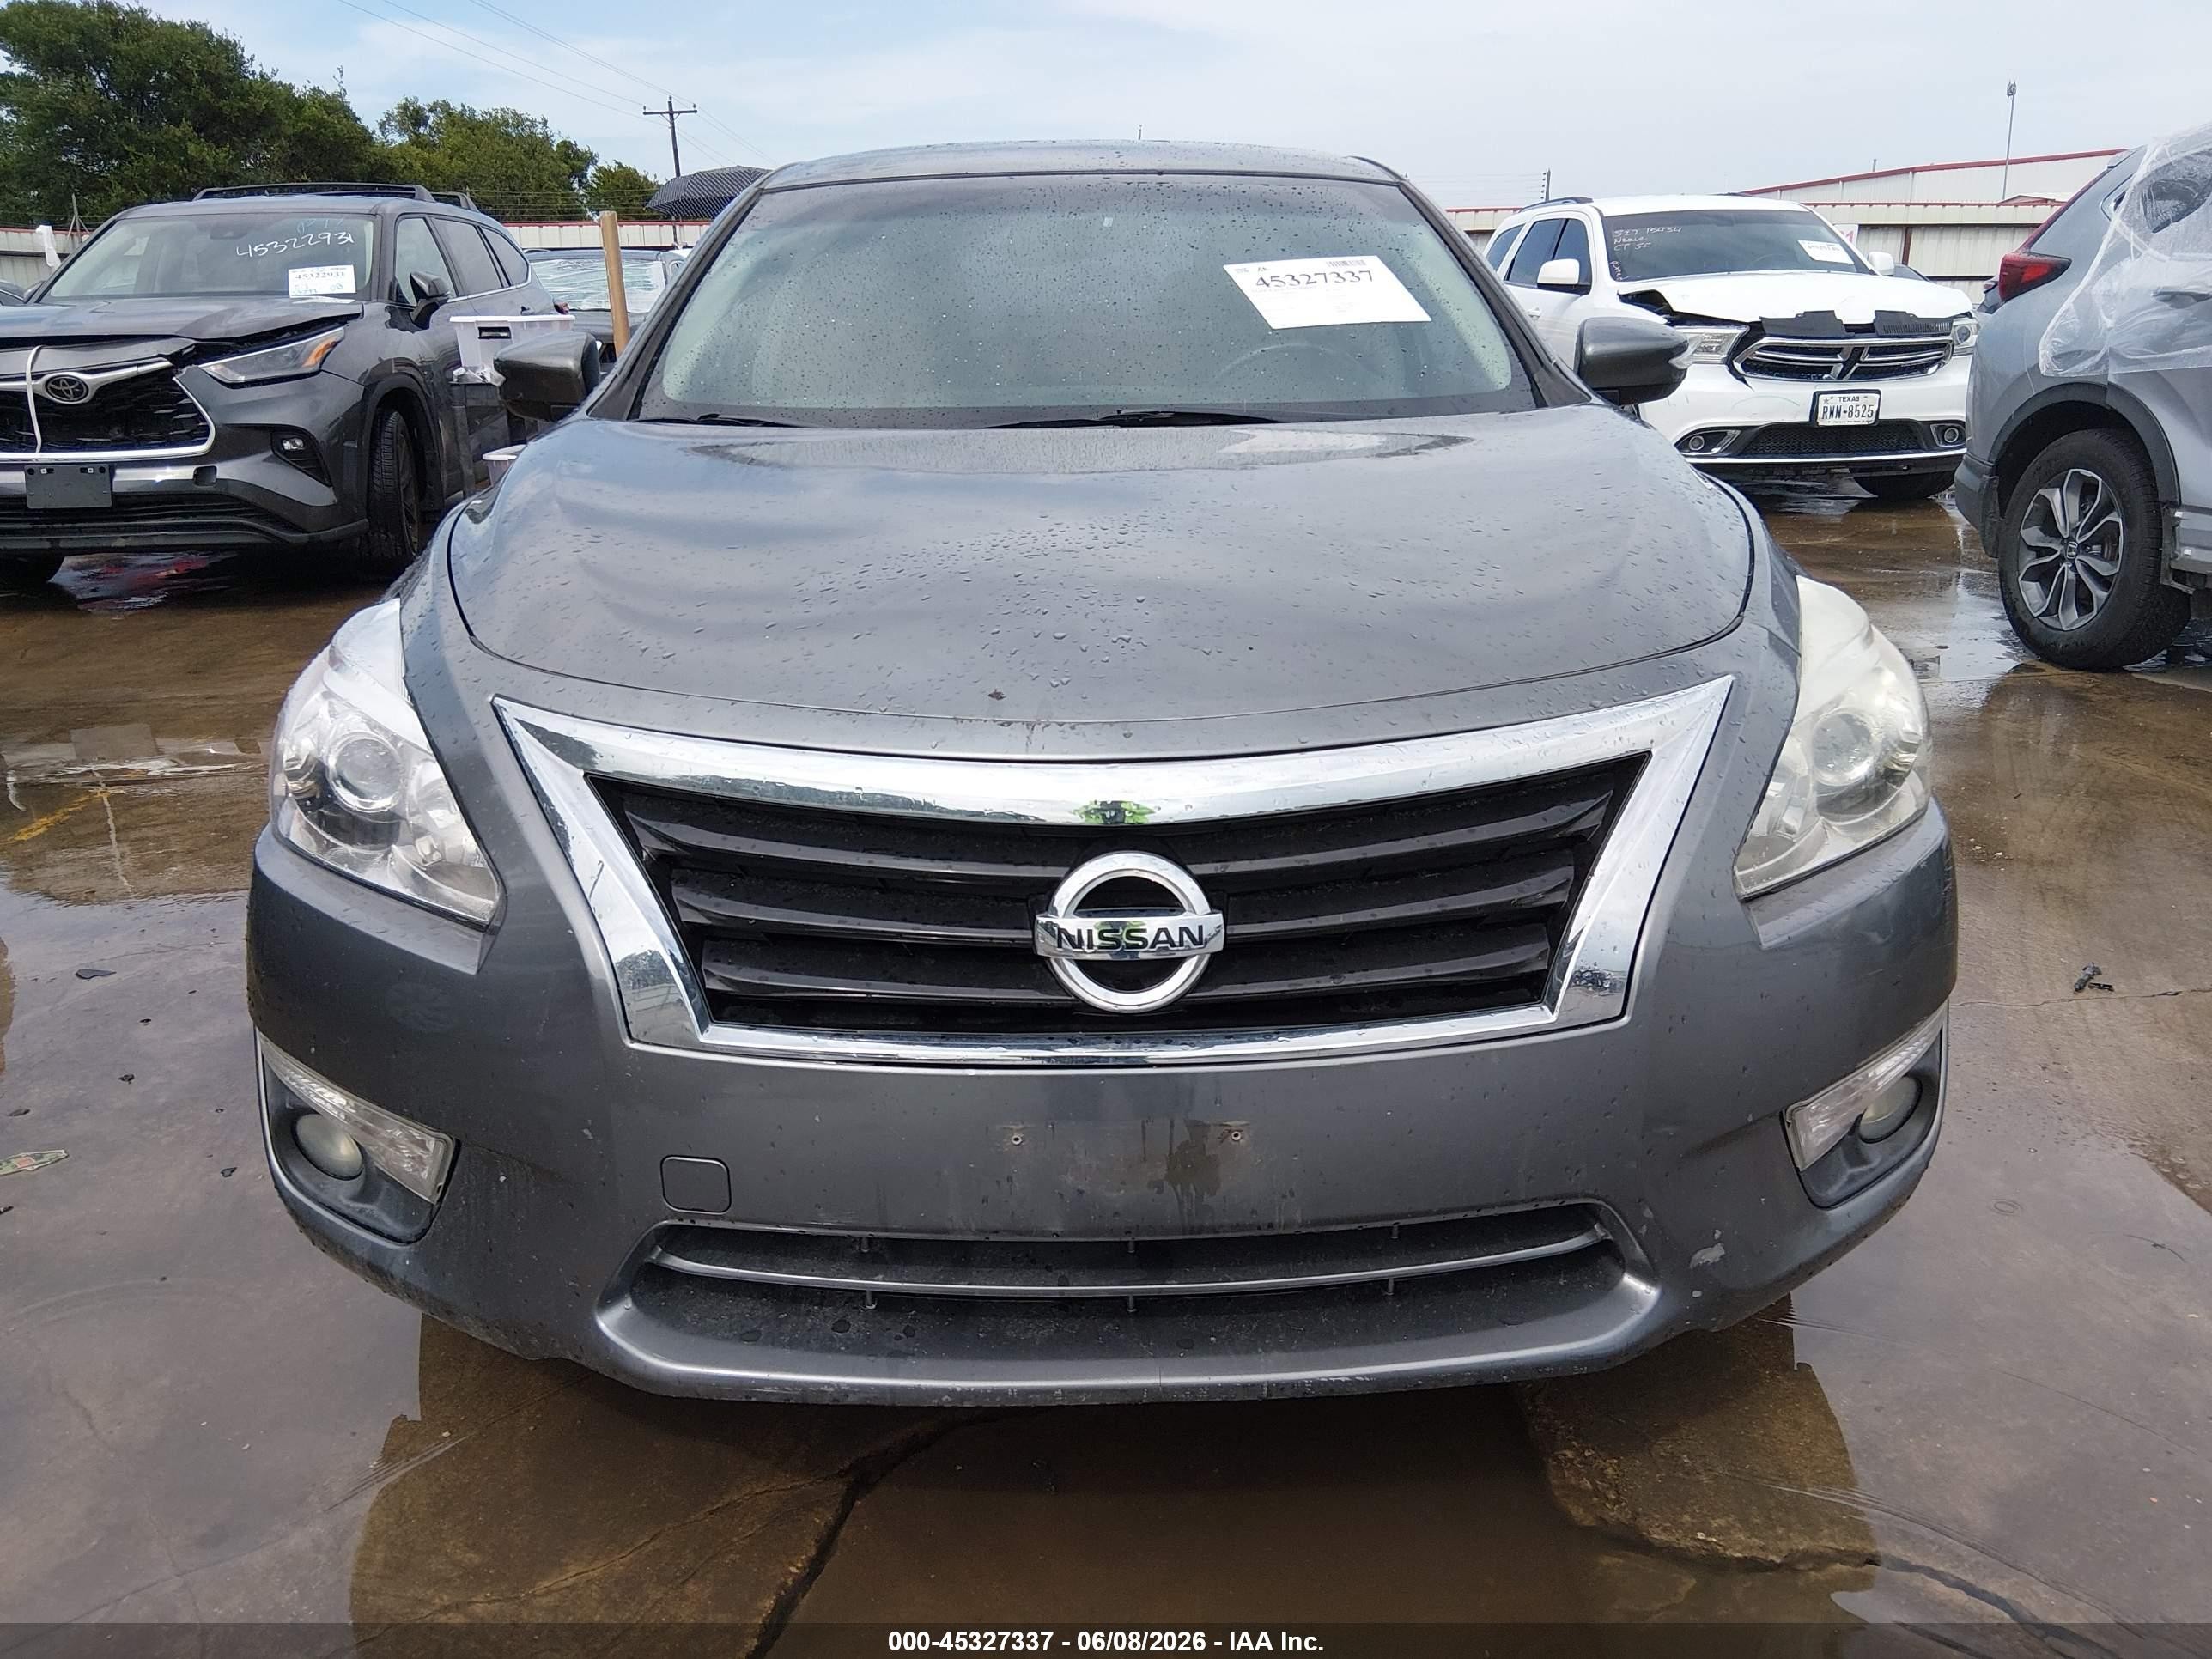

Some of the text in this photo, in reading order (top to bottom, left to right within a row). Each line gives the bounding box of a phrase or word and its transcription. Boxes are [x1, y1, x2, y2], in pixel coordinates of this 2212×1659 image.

[235, 231, 355, 258] 45322931
[1255, 270, 1374, 288] 45327337
[1056, 924, 1204, 951] NISSAN
